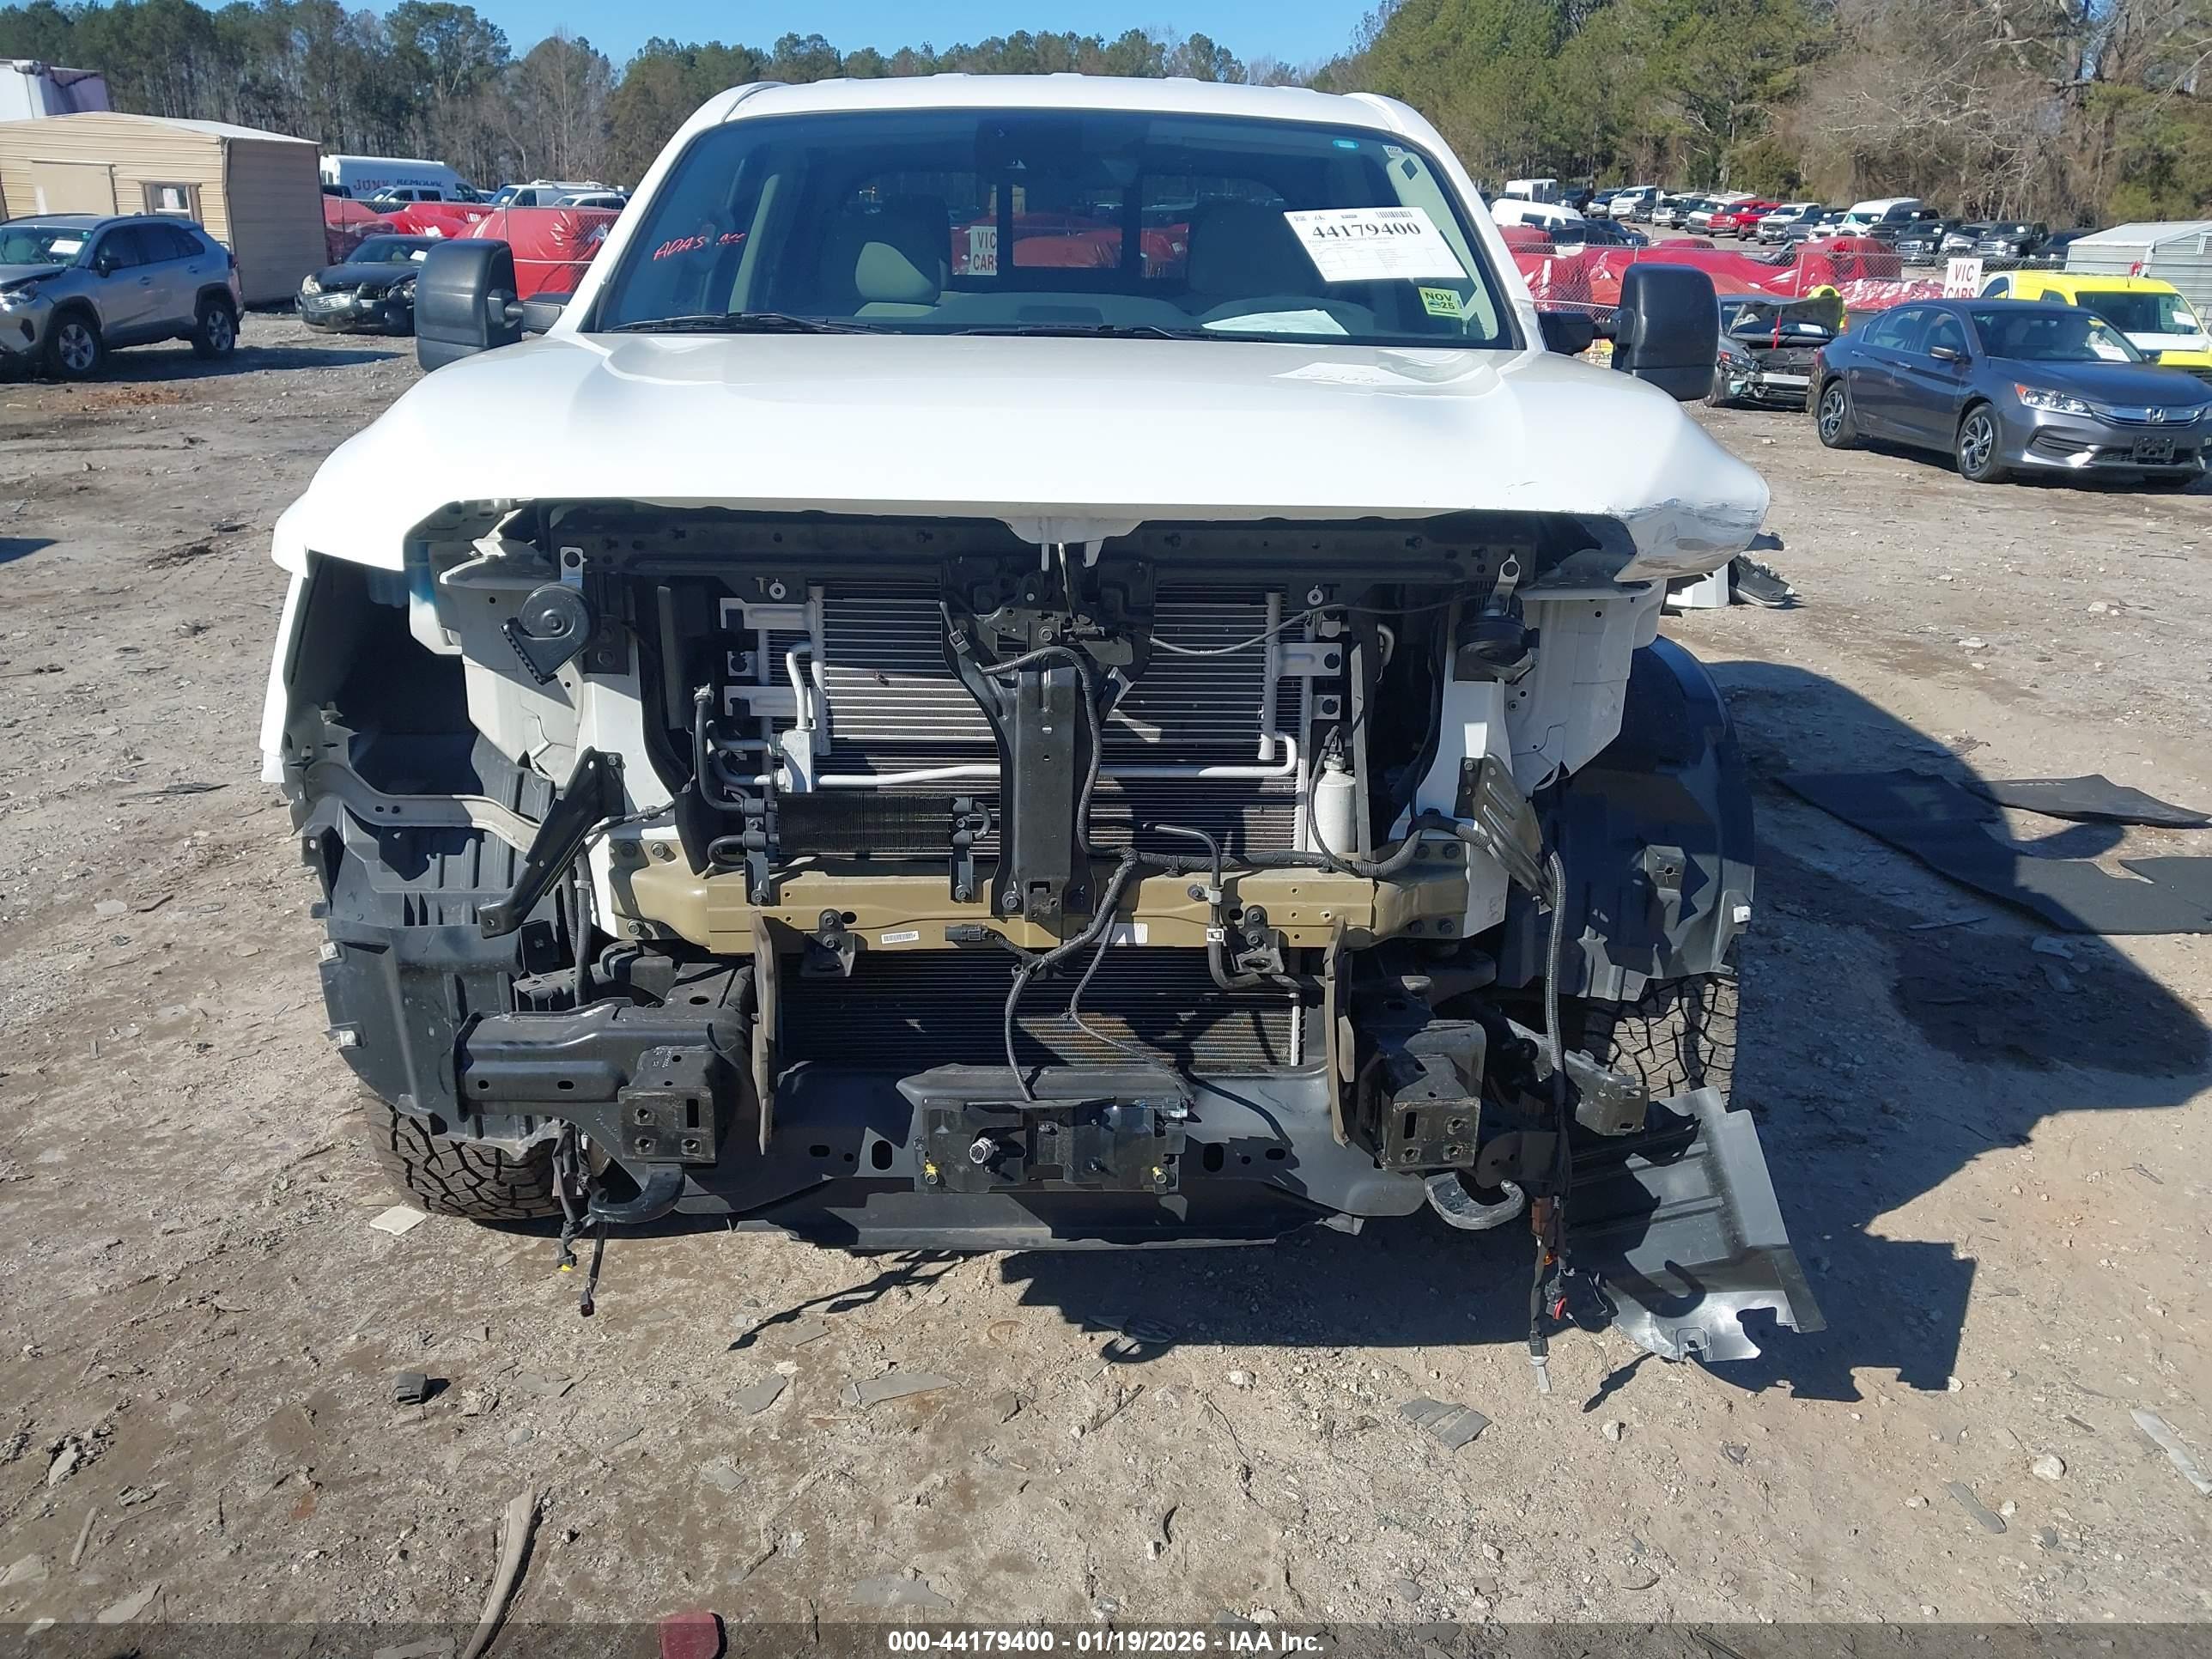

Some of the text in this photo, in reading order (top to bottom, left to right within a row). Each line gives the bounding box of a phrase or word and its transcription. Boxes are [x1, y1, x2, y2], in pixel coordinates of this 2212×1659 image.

[1313, 222, 1421, 239] 44179400
[653, 236, 706, 261] ADAS
[977, 232, 997, 249] VIC
[973, 253, 997, 271] CAR
[1954, 264, 1975, 283] VIC
[1425, 292, 1452, 302] NOV
[1440, 301, 1455, 310] 25
